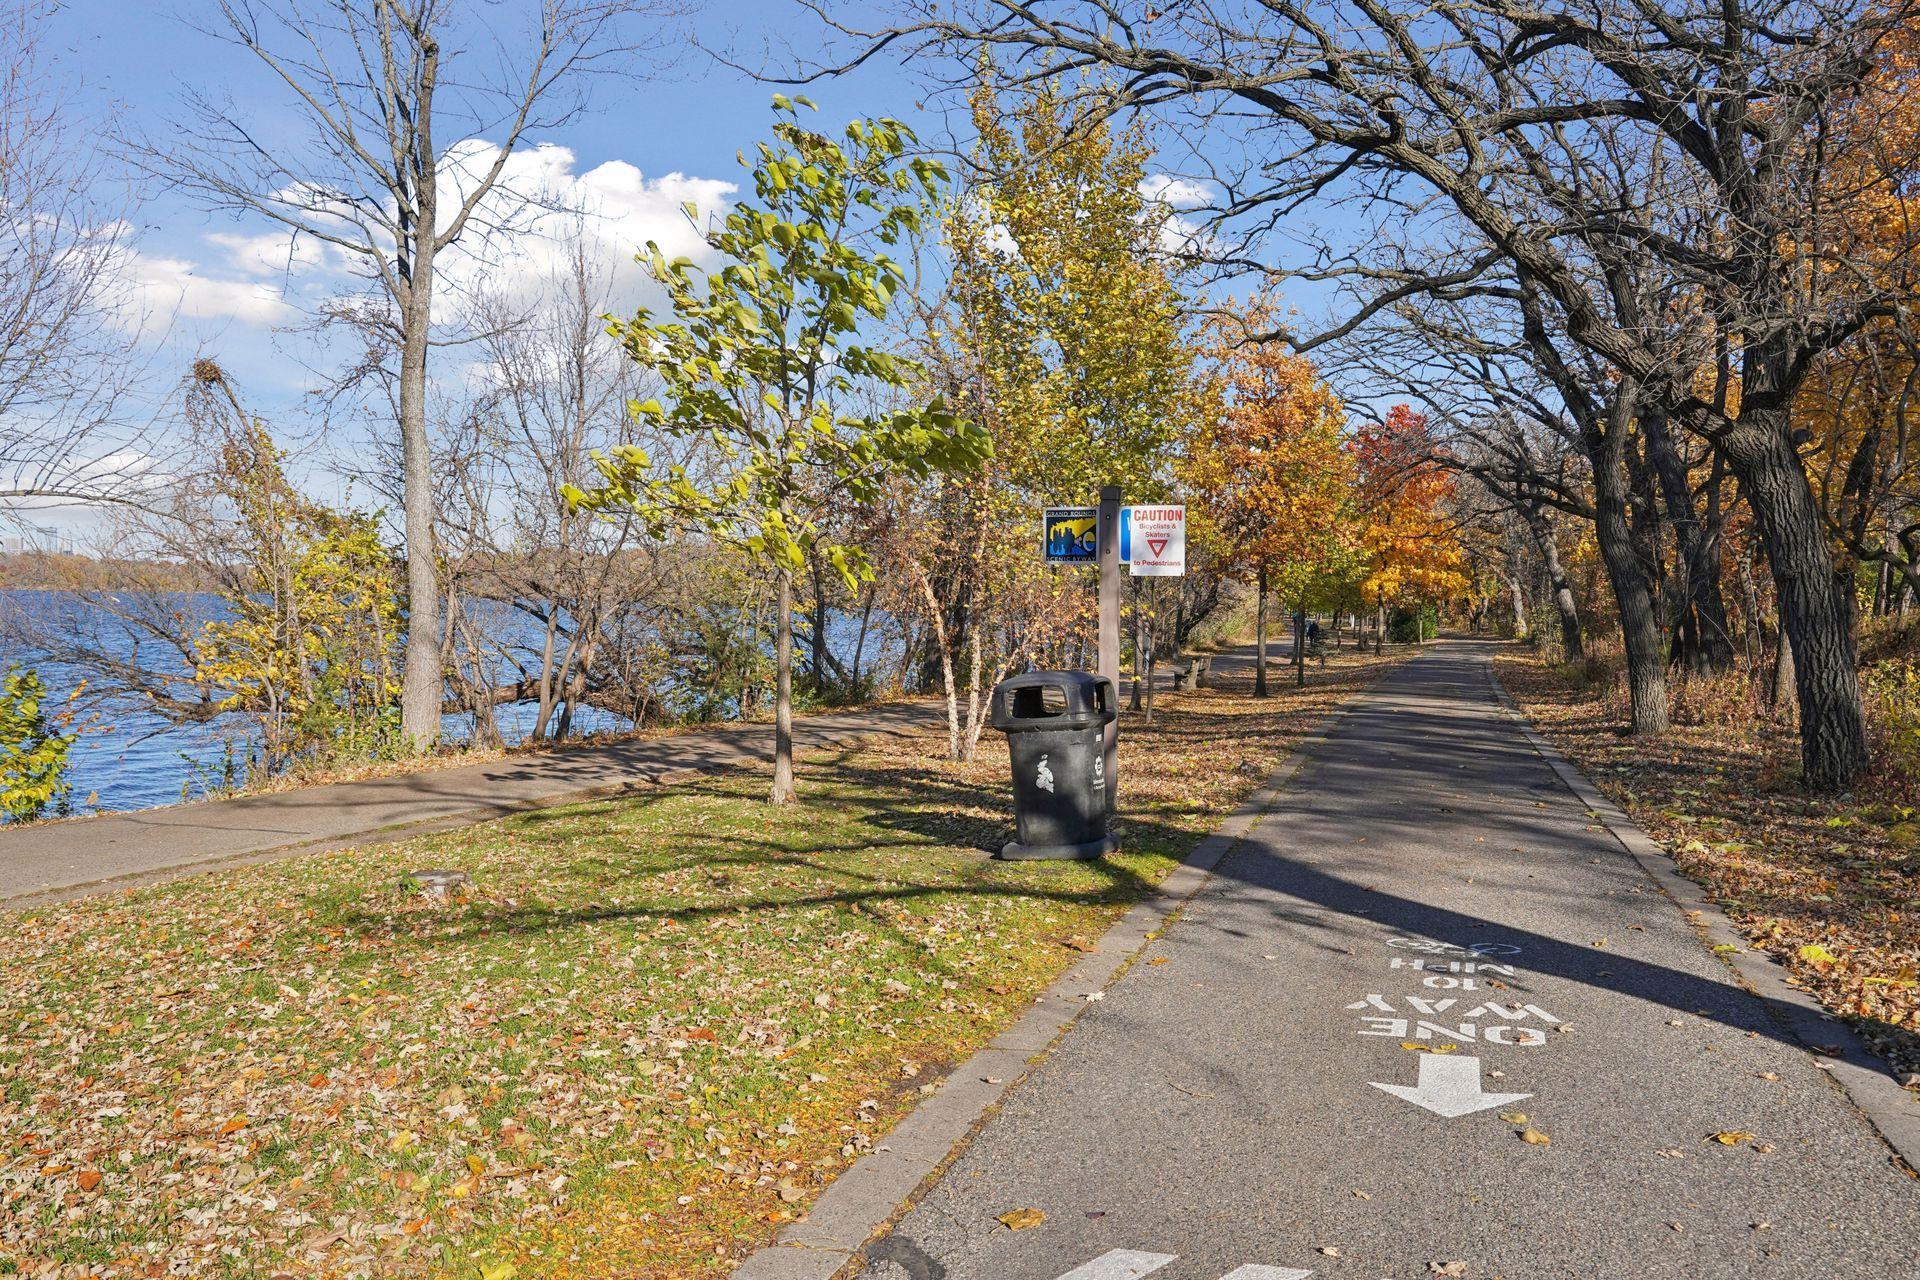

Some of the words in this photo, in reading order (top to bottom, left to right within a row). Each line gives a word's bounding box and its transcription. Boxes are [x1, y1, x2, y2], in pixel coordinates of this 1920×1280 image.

[1133, 509, 1183, 521] CAUTION
[1139, 523, 1170, 531] Bicyclists
[1390, 958, 1514, 976] MPH
[1422, 976, 1479, 991] 10
[1345, 993, 1562, 1023] WAY
[1357, 1016, 1547, 1046] ONE
